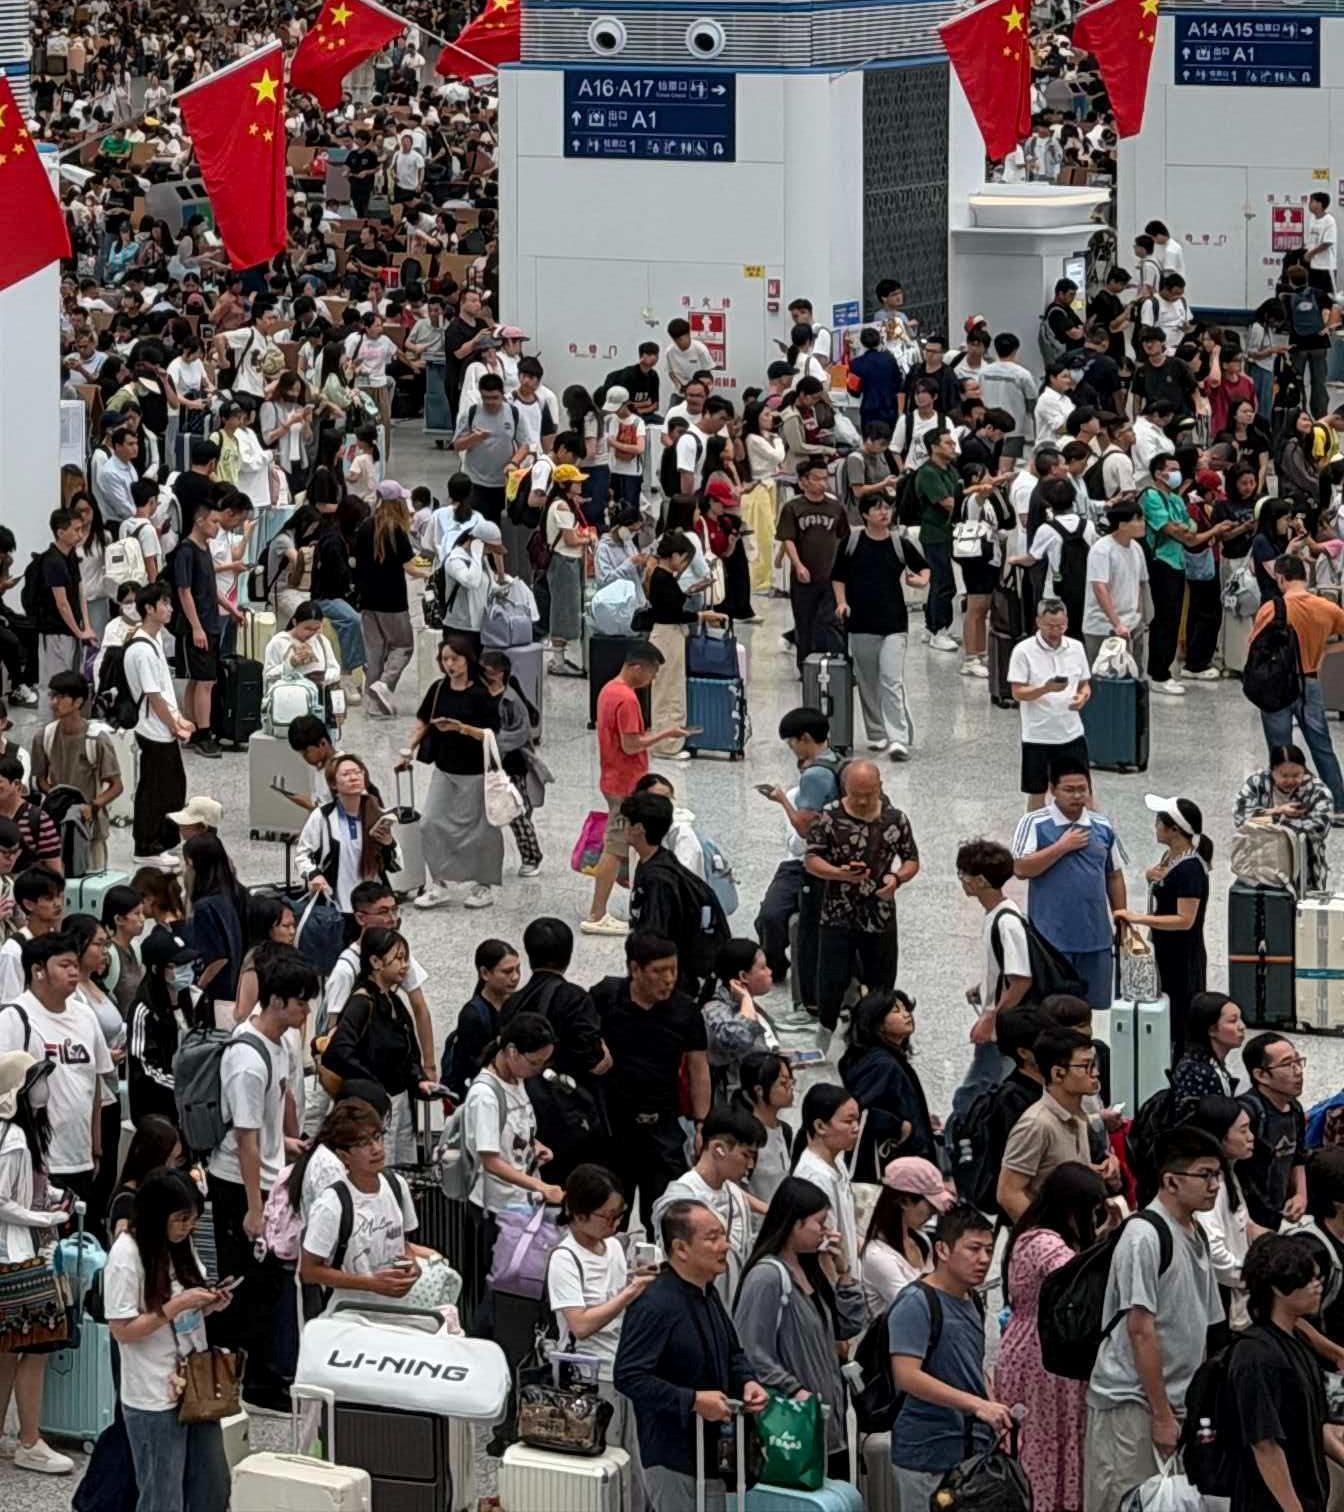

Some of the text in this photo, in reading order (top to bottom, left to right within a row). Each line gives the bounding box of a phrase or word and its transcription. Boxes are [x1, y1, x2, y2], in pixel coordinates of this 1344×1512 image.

[1232, 47, 1255, 62] A1
[632, 111, 657, 129] A1
[326, 1349, 470, 1382] LI-NING
